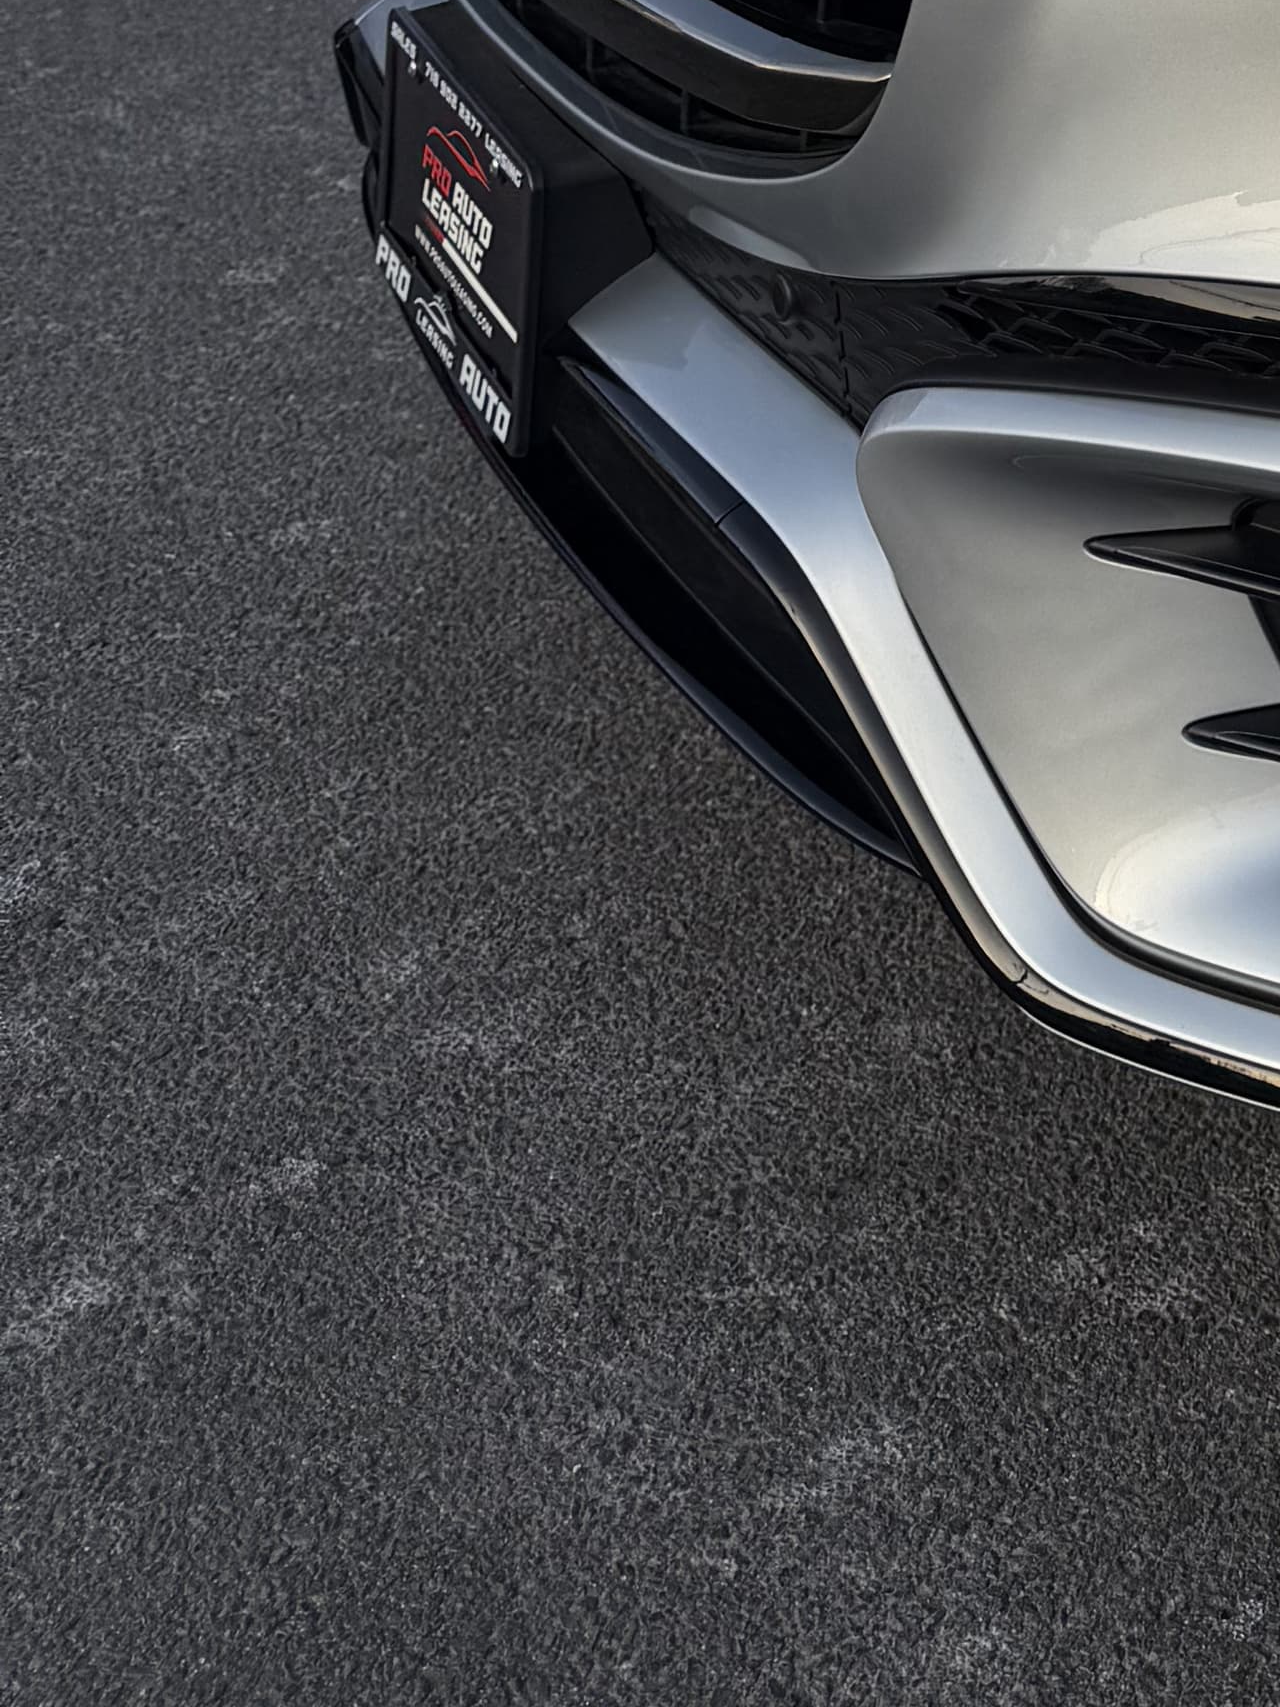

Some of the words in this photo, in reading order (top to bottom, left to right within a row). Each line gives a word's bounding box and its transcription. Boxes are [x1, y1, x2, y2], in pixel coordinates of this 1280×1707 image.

[421, 143, 453, 199] PRO
[452, 181, 493, 251] AUTO
[484, 132, 523, 189] LEASING
[421, 177, 485, 276] LEASING
[375, 233, 412, 303] PRO
[415, 308, 455, 370] LEASING
[459, 352, 512, 445] AUTO
